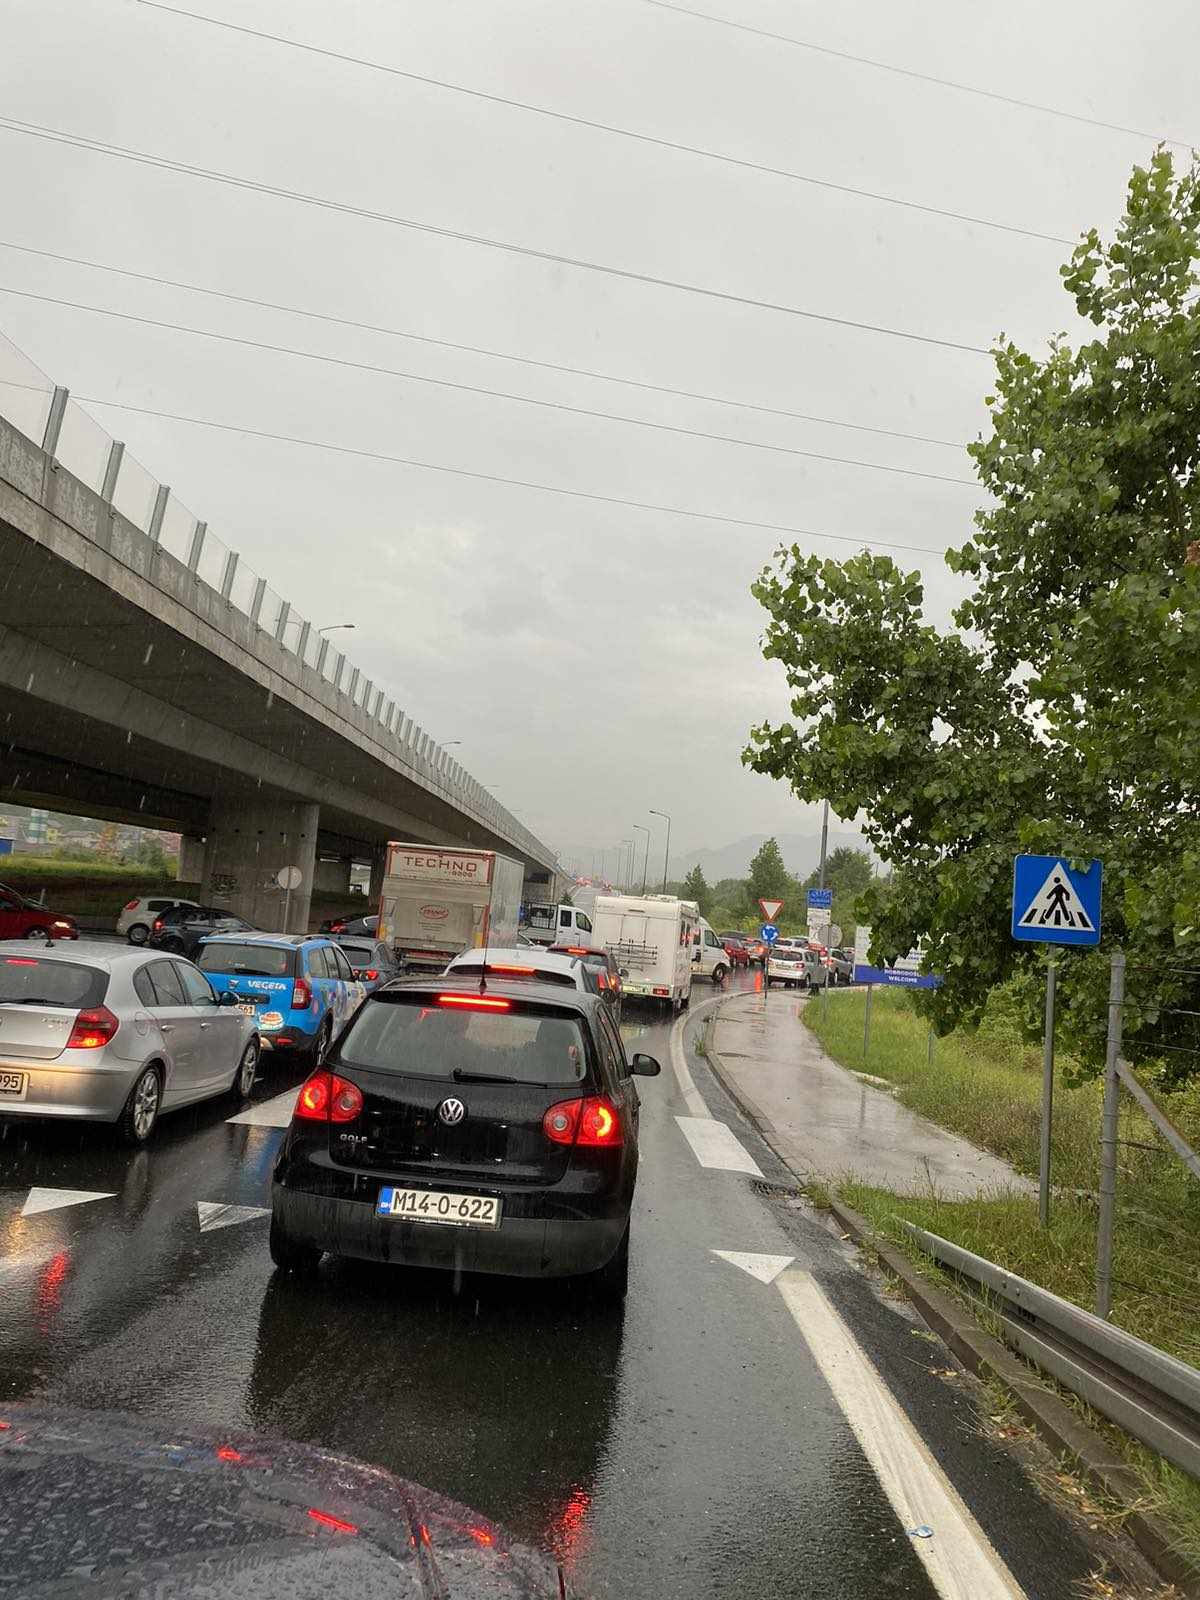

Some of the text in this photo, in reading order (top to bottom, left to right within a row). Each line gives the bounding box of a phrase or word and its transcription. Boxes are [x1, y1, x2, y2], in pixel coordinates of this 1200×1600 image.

[403, 856, 477, 872] TECHNO
[888, 975, 918, 983] WELCOME
[247, 980, 287, 990] VEGETA
[340, 1133, 368, 1143] GOLF
